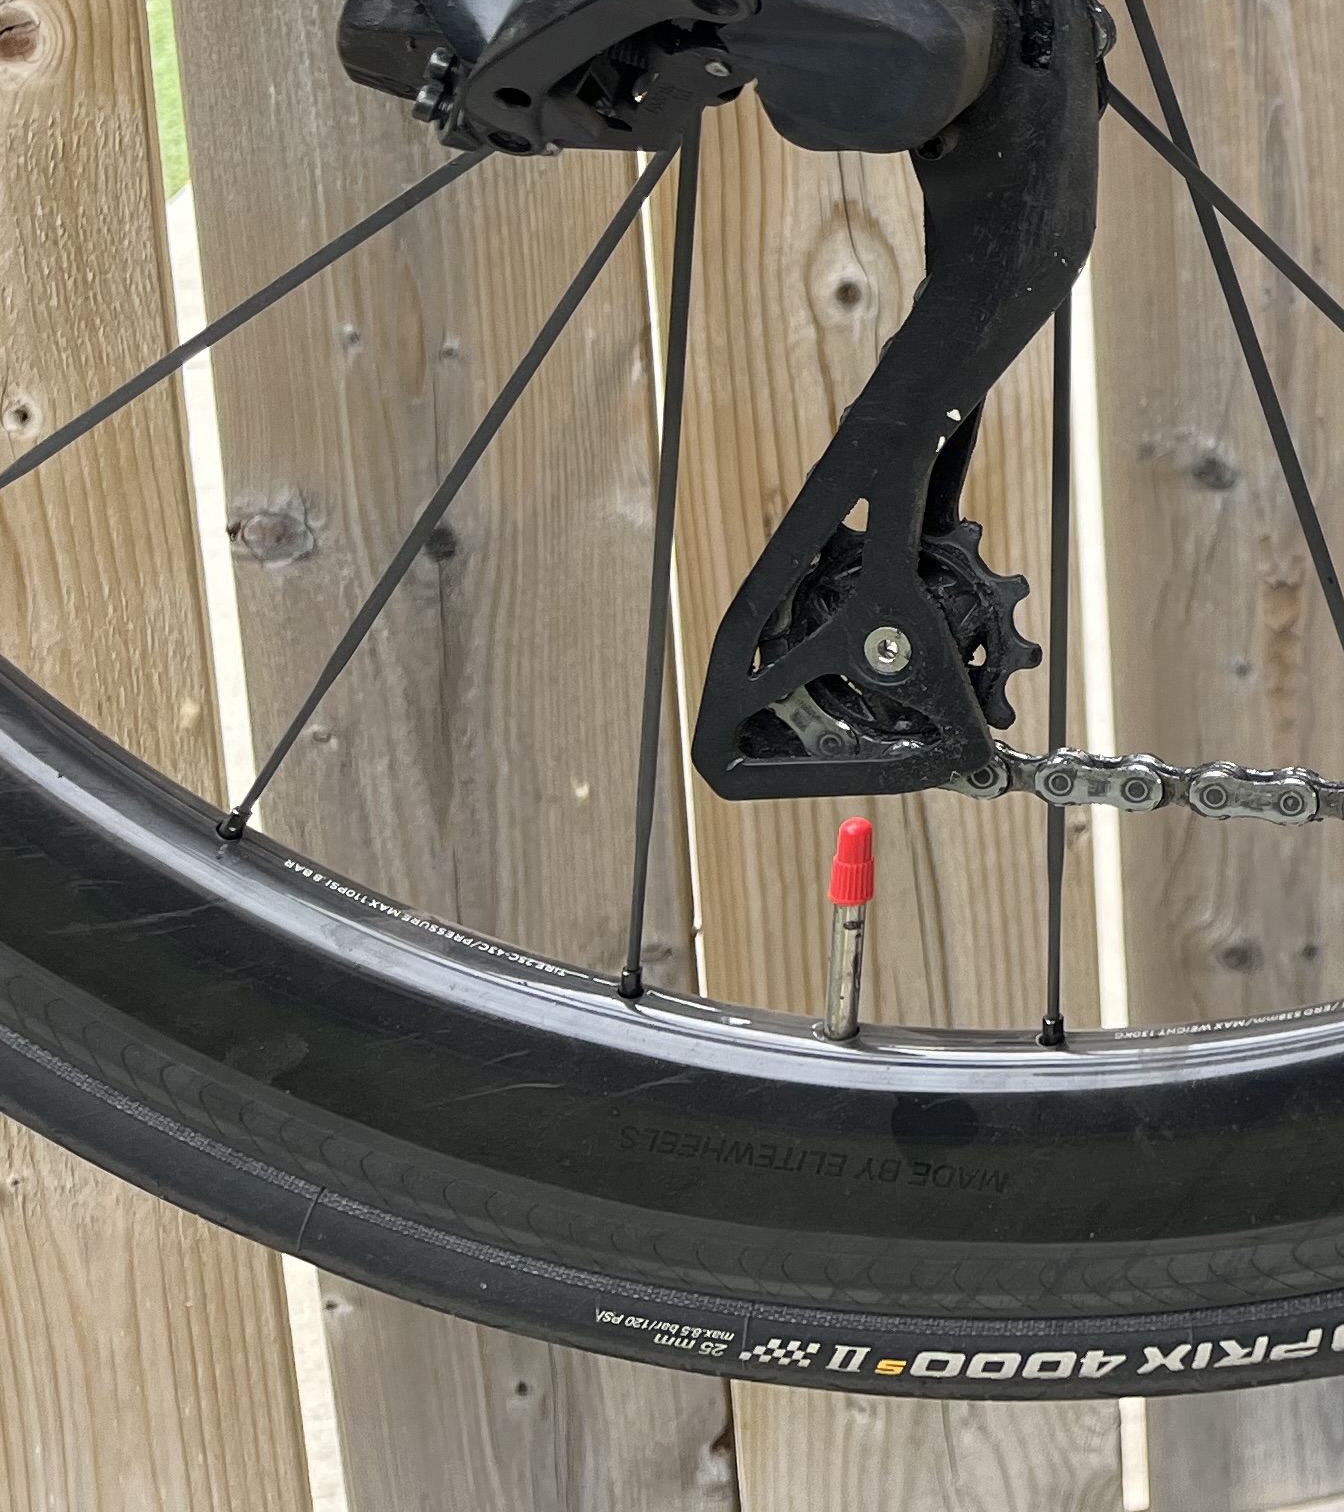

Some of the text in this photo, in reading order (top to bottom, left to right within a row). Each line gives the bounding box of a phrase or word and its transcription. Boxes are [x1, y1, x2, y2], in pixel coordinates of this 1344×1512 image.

[284, 859, 312, 879] BAR
[369, 898, 400, 919] MAX
[618, 1125, 1010, 1194] MADE BY ELITEWHEELS
[624, 1317, 680, 1335] bar/120
[653, 1333, 728, 1357] 25 mm
[1137, 1328, 1323, 1376] PRIX
[828, 1344, 871, 1373] II
